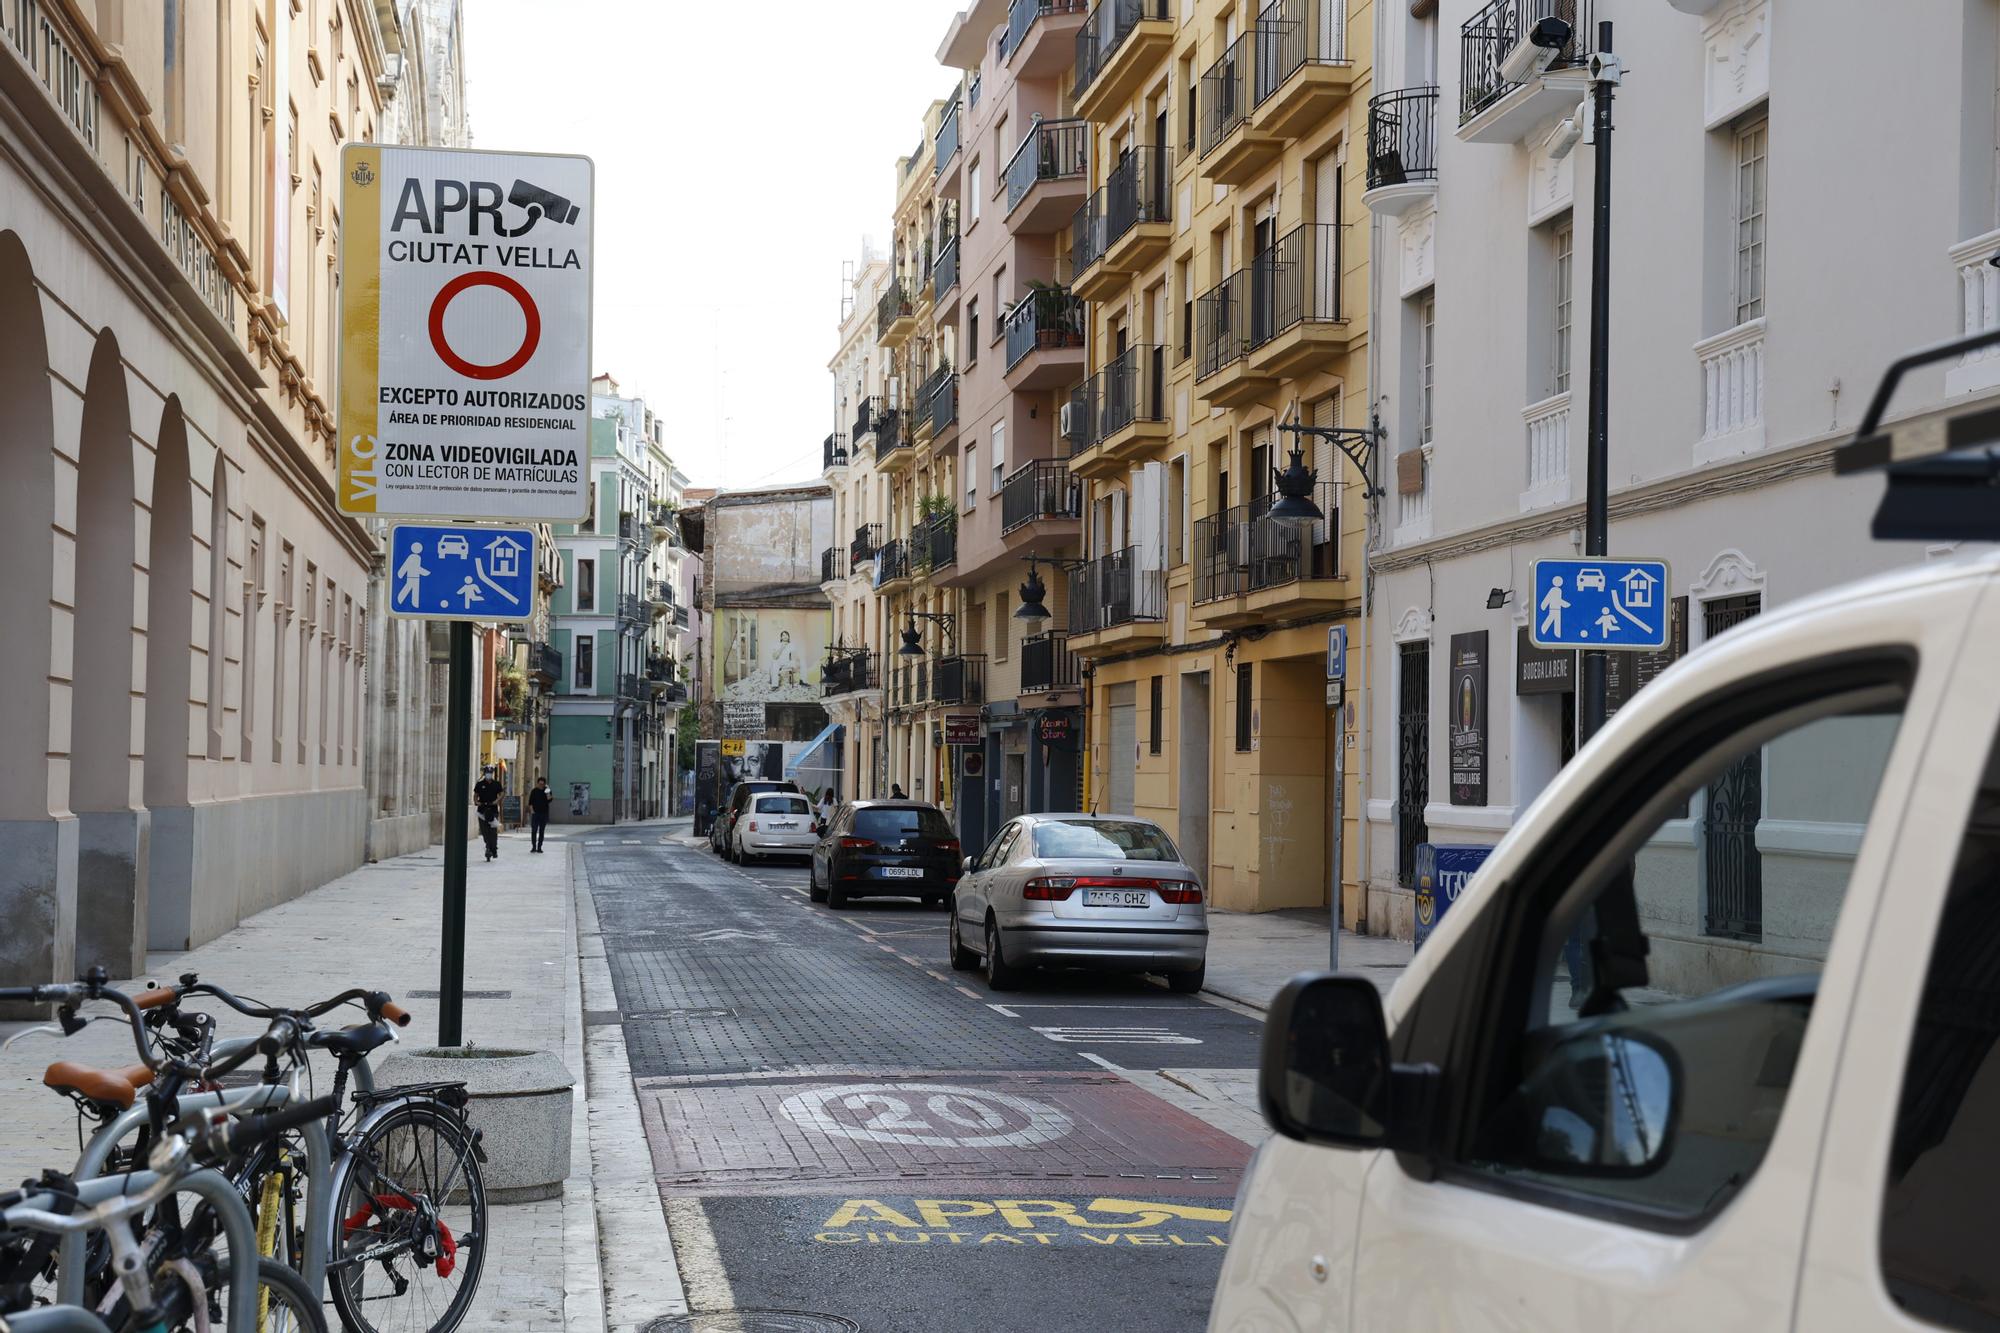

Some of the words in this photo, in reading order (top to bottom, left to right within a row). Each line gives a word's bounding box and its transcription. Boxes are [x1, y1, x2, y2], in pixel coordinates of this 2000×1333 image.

[390, 177, 507, 237] APR
[388, 240, 489, 265] CIUTAT
[496, 245, 581, 270] VELLA
[380, 387, 458, 407] EXCEPTO
[463, 390, 586, 411] AUTORIZADOS
[389, 410, 420, 425] ÁREA
[423, 414, 437, 425] DE
[440, 415, 501, 428] PRIORIDAD
[504, 417, 576, 430] RESIDENCIAL
[385, 443, 435, 462] ZONA
[440, 445, 578, 467] VIDEOVIGILADA
[351, 434, 378, 501] VLC
[385, 464, 416, 478] CON
[418, 465, 469, 480] LECTOR
[473, 467, 491, 480] DE
[495, 466, 578, 483] MATRÍCULAS
[1330, 631, 1341, 674] P
[1523, 661, 1545, 681] BODEGA
[1552, 658, 1568, 678] BENE
[1453, 772, 1466, 785] BODEGA
[1471, 772, 1481, 785] BENE
[888, 868, 906, 876] 0695
[1124, 892, 1147, 905] CHZ
[843, 1094, 1008, 1129] 20
[822, 1199, 1088, 1229] APR
[814, 1231, 1060, 1246] CIUTAT
[1080, 1233, 1230, 1246] VELL
[355, 1241, 400, 1262] ORBEA
